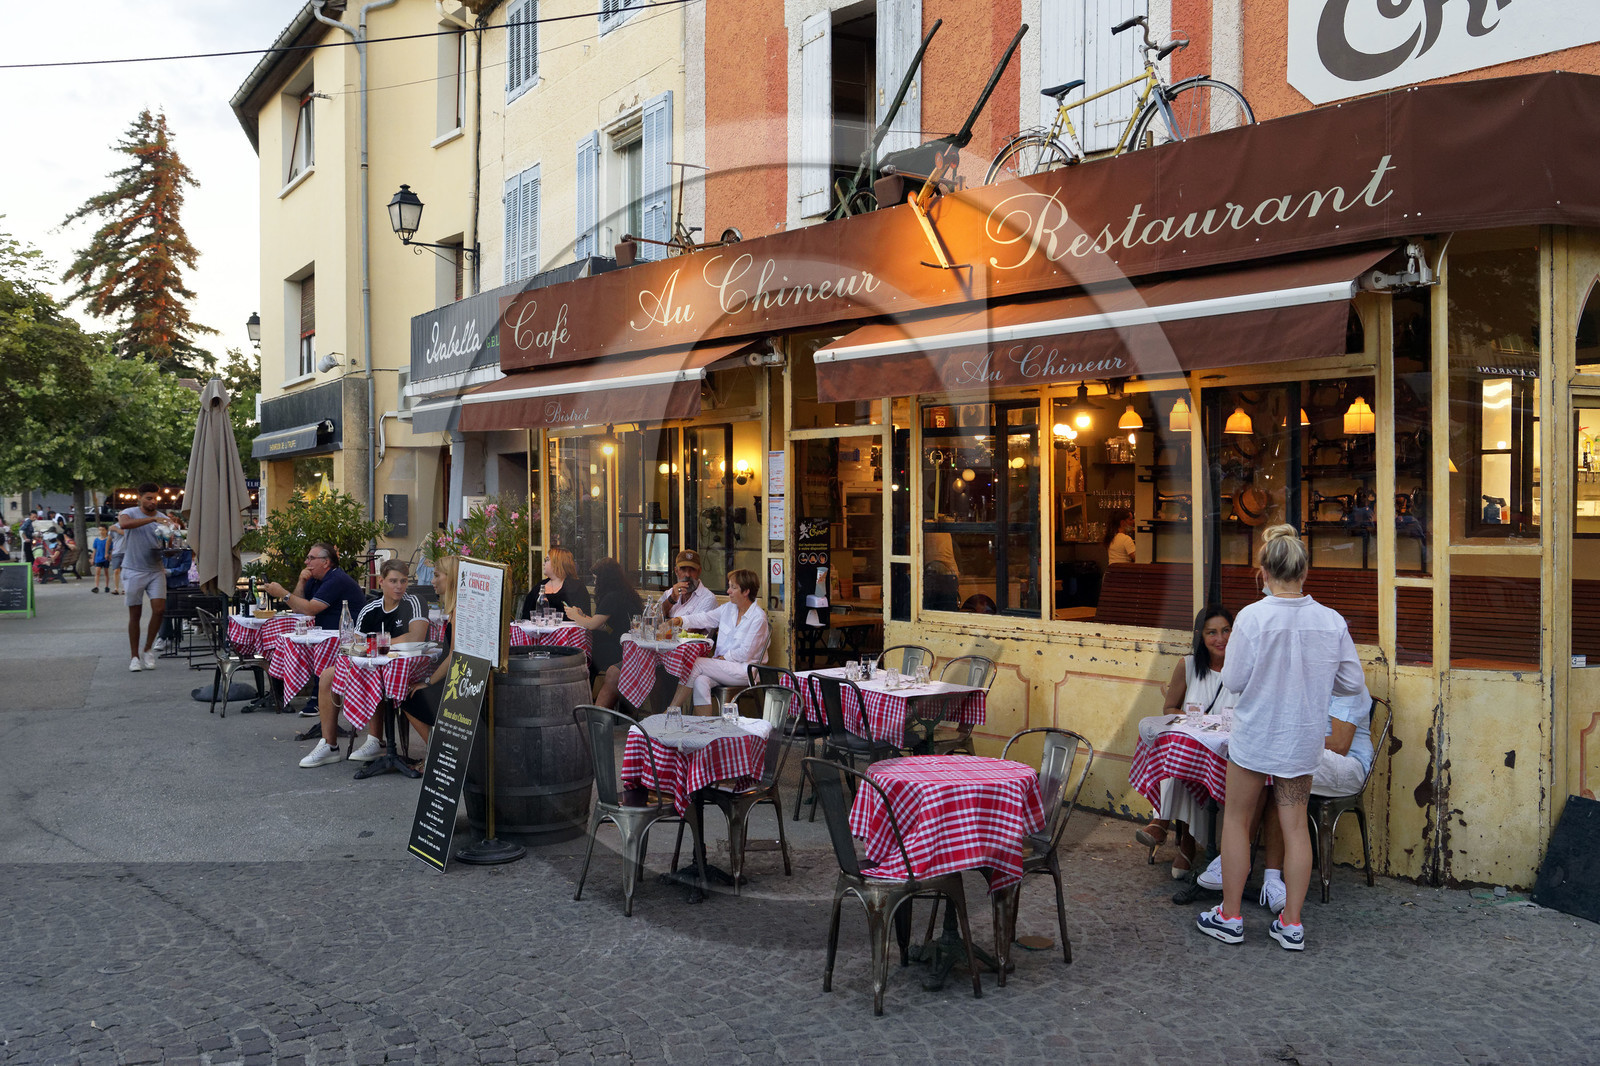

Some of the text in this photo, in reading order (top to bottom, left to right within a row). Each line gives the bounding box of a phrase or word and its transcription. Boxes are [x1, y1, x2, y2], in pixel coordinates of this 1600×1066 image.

[504, 154, 1397, 358] Café Au Chineur Restaurant
[426, 318, 482, 364] Isabella
[956, 345, 1126, 384] Au Chineur
[545, 401, 589, 423] Bistrot
[468, 577, 490, 592] CHINEUR
[458, 678, 485, 698] Chineur
